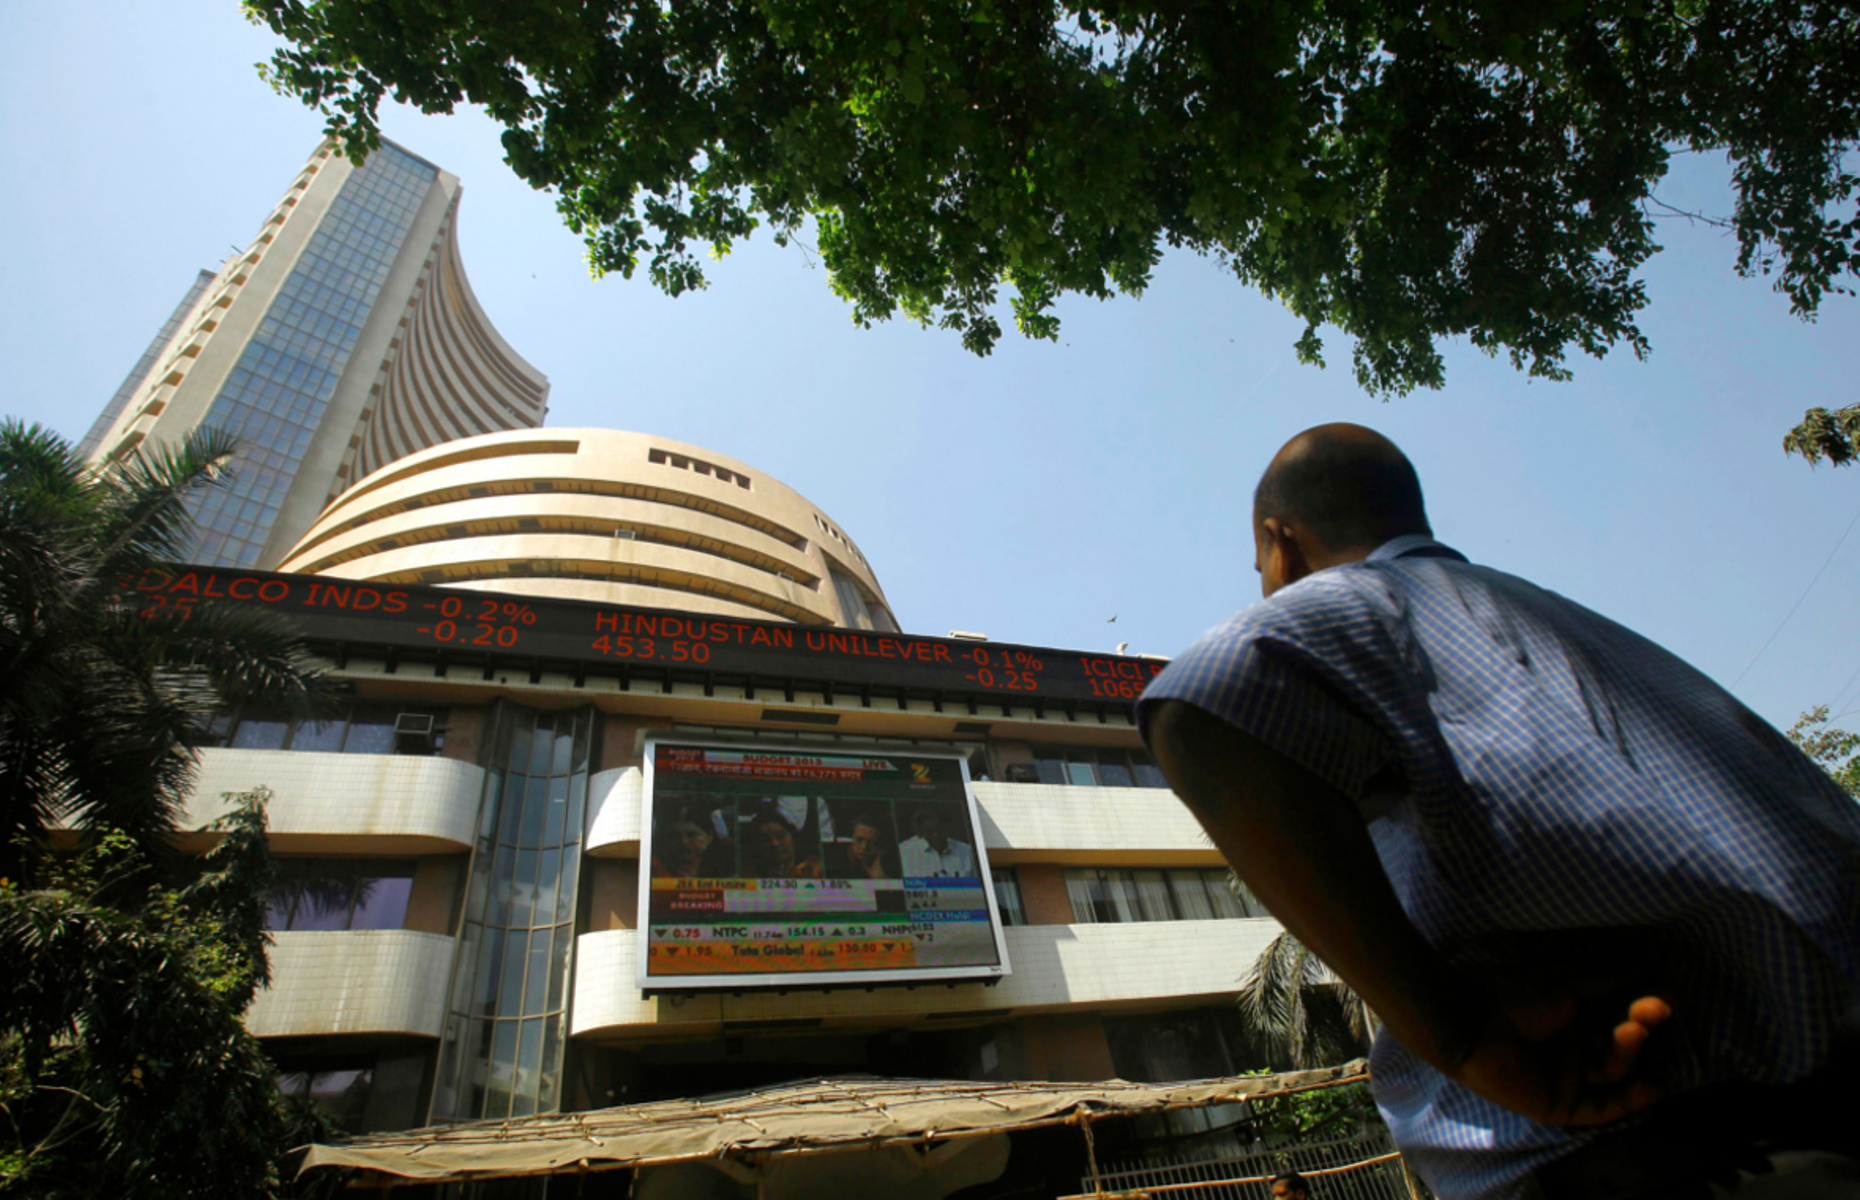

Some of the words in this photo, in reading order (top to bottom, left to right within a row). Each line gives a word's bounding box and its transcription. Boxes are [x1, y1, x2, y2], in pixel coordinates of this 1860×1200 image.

[303, 584, 410, 612] INDS
[423, 597, 538, 624] -0.2%
[417, 620, 518, 647] -0.20
[595, 611, 793, 648] HINDUSTAN
[806, 631, 954, 663] UNILEVER
[961, 647, 1044, 672] -0.1%
[592, 635, 710, 663] 453.50
[966, 668, 1039, 691] -0.25
[1080, 657, 1144, 680] ICICI
[742, 755, 791, 765] BUDGET
[795, 757, 822, 767] 2013
[862, 760, 888, 770] LIVE
[670, 901, 723, 910] BREAKING
[672, 928, 700, 938] 0.75
[713, 927, 749, 938] NTPC
[787, 926, 825, 937] 154.15
[685, 946, 713, 956] 1.95
[731, 945, 760, 956] Tata
[762, 944, 805, 956] Global
